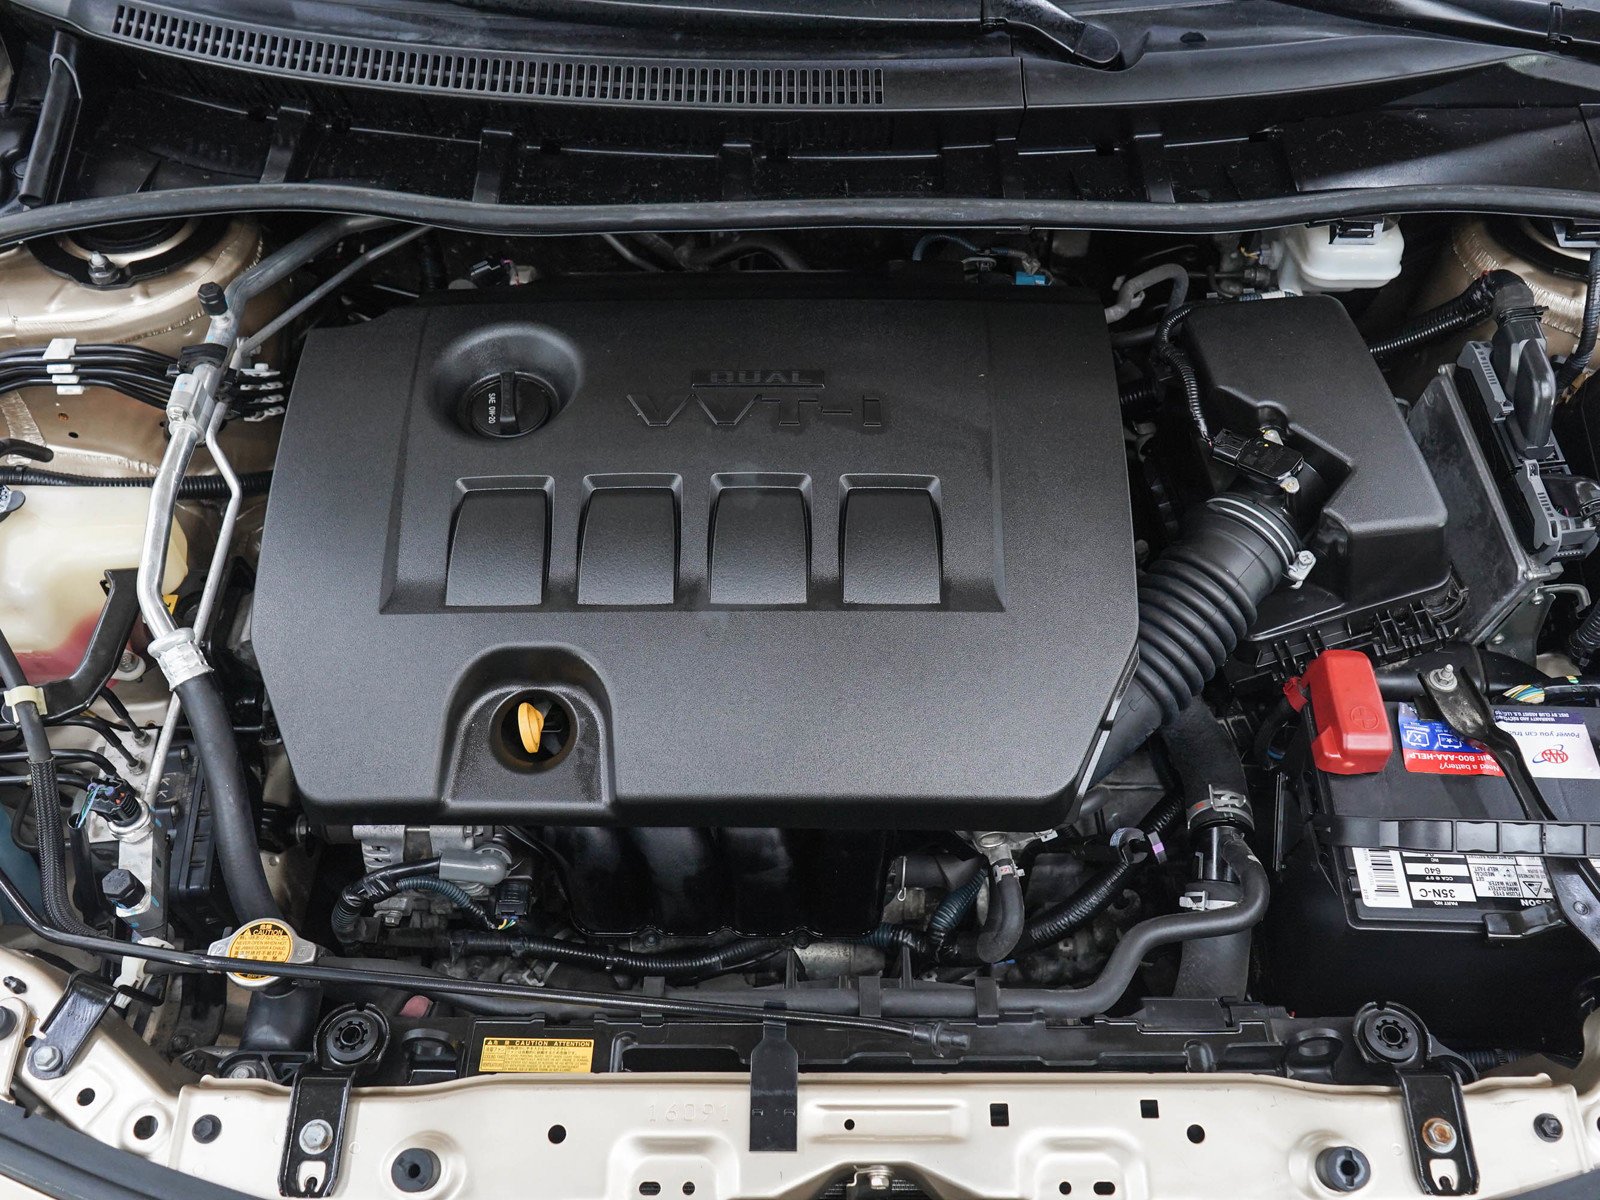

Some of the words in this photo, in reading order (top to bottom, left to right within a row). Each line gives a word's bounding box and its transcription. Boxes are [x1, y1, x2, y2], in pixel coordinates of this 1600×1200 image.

[710, 370, 813, 384] DUAL
[488, 392, 496, 404] SAE
[1543, 749, 1567, 763] AAA
[1439, 762, 1470, 770] battery?
[1480, 764, 1500, 772] Need
[1424, 867, 1441, 875] 640
[1419, 888, 1456, 898] 35N-C
[648, 1103, 730, 1122] 16091
